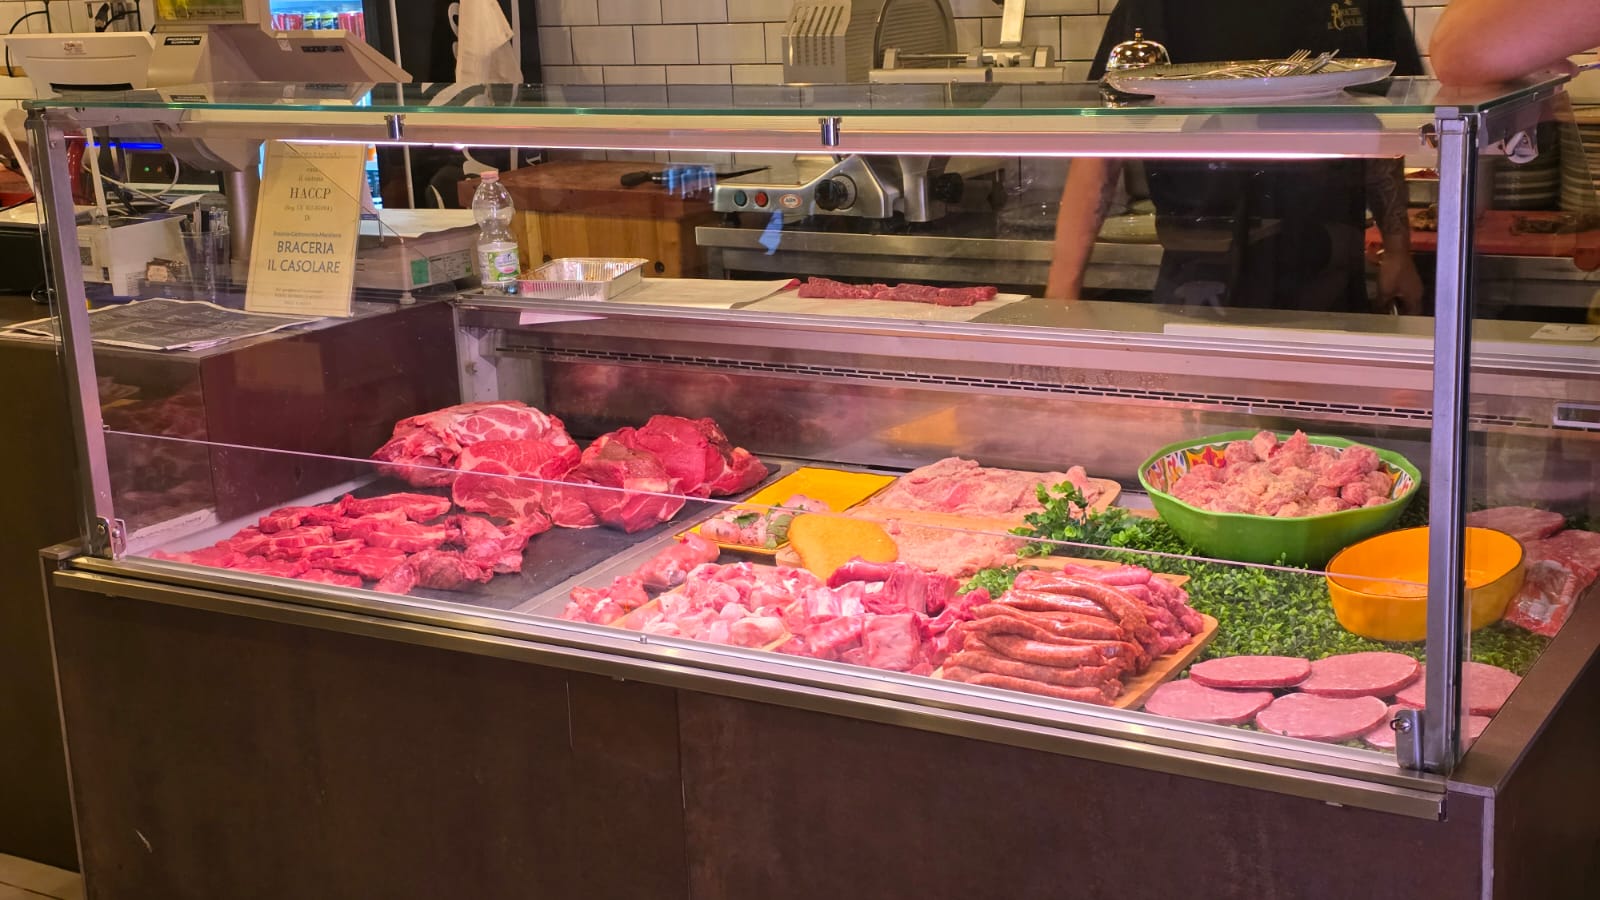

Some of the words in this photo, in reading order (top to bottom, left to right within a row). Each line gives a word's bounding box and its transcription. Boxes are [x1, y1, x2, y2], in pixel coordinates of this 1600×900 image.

[290, 187, 331, 199] HACCP
[277, 240, 335, 254] BRACERIA
[267, 259, 277, 271] IL
[280, 259, 341, 273] CASOLARE
